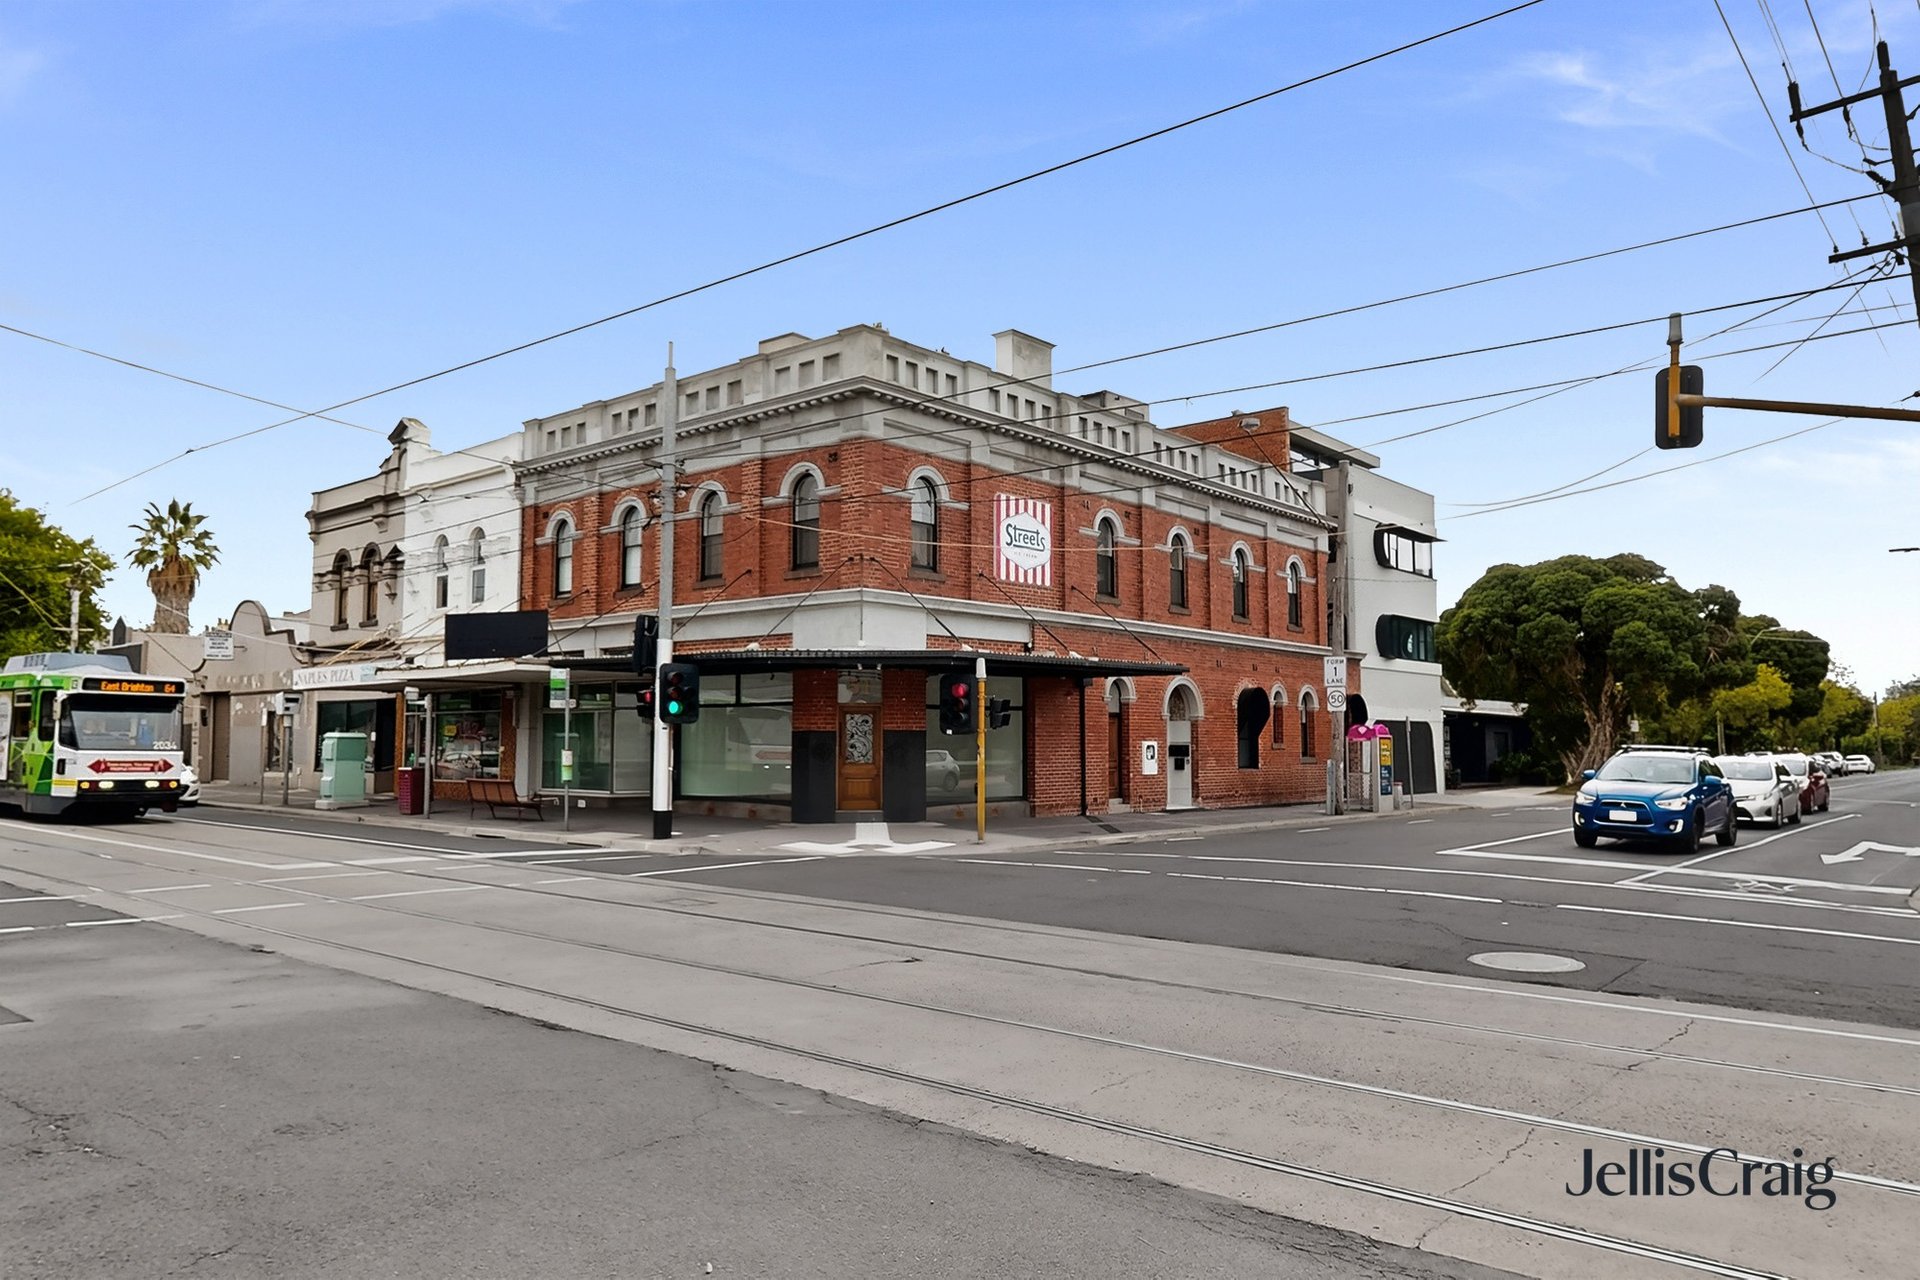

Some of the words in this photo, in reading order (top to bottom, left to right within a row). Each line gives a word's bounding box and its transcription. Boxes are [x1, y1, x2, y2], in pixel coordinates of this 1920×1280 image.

[1005, 523, 1046, 552] Streets
[296, 670, 327, 685] NAPLES
[330, 668, 355, 683] PIZZA
[1333, 666, 1338, 677] 1
[101, 681, 120, 691] East
[121, 682, 155, 692] Brighton
[164, 684, 176, 693] 64
[1330, 694, 1344, 704] 50
[152, 741, 177, 750] 2034
